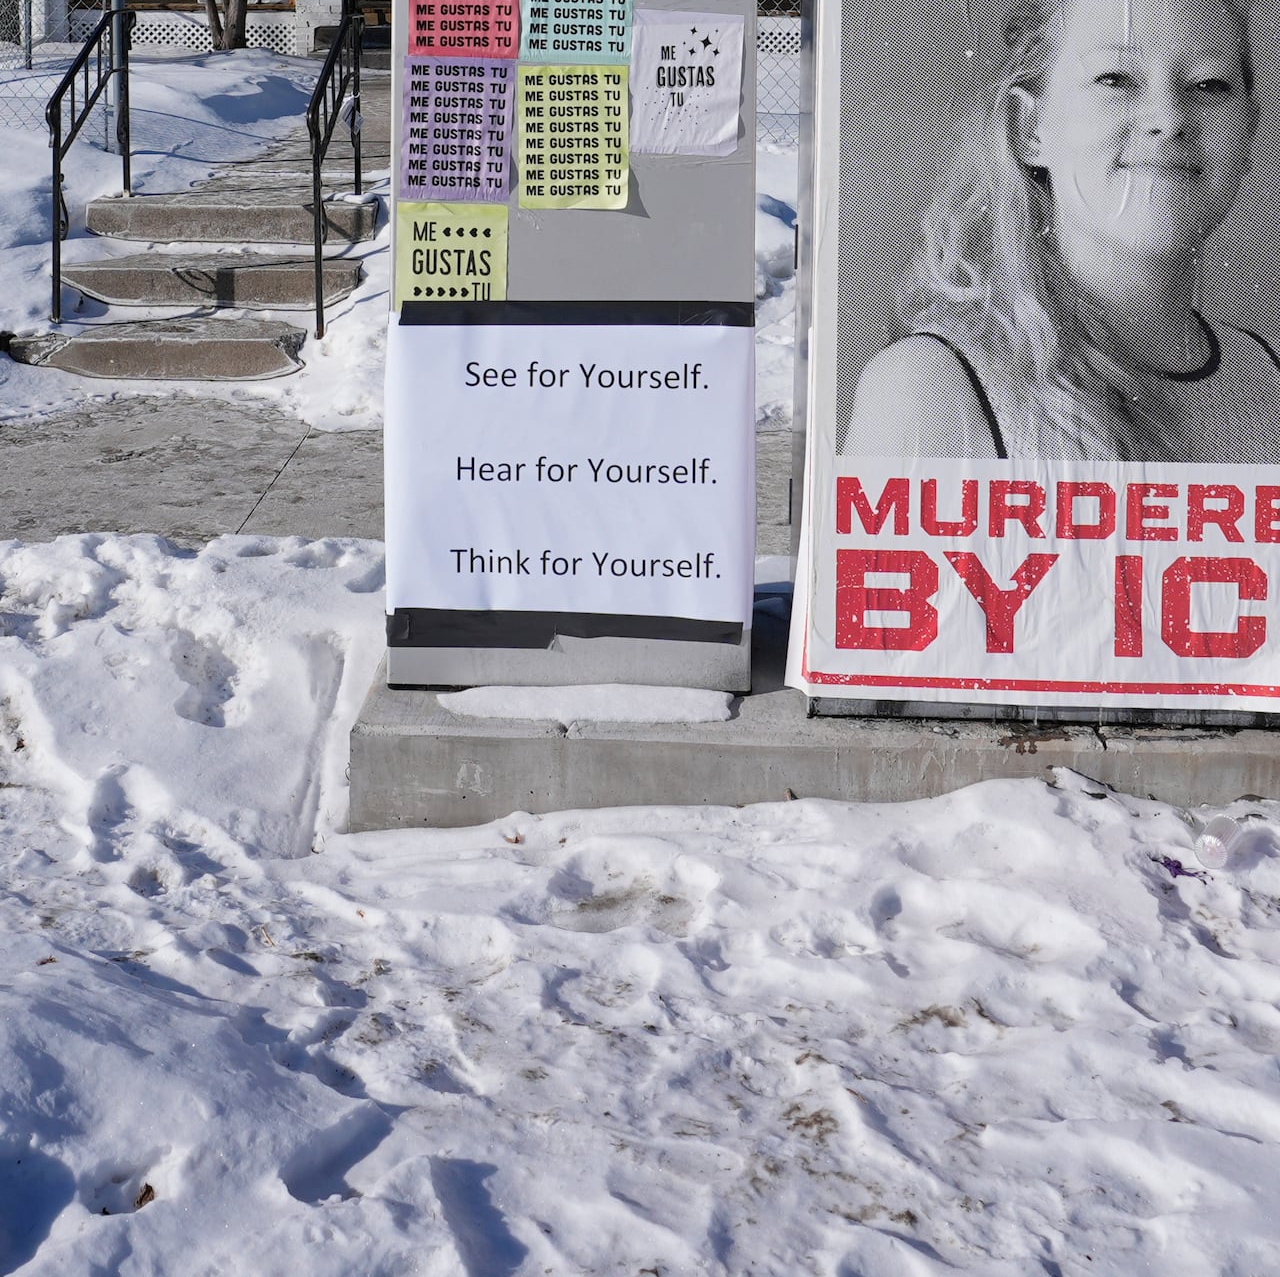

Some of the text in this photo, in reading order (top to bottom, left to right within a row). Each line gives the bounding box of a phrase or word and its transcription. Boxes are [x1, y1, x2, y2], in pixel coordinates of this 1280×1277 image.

[417, 5, 512, 15] ME GUSTAS TU
[531, 8, 625, 20] ME GUSTAS TU
[417, 20, 511, 31] ME GUSTAS TU
[530, 23, 624, 36] ME GUSTAS TU
[416, 36, 511, 47] ME GUSTAS TU
[529, 39, 624, 52] ME GUSTAS TU
[661, 46, 676, 60] ME
[412, 65, 507, 78] ME GUSTAS TU
[657, 66, 715, 87] GUSTAS
[526, 75, 620, 85] ME GUSTAS TU
[411, 81, 506, 94] ME GUSTAS TU
[526, 91, 620, 101] ME GUSTAS TU
[669, 92, 684, 107] TU
[411, 97, 505, 109] ME GUSTAS TU
[526, 106, 620, 117] ME GUSTAS TU
[411, 112, 504, 125] ME GUSTAS TU
[526, 122, 620, 132] ME GUSTAS TU
[410, 128, 503, 141] ME GUSTAS TU
[527, 138, 621, 148] ME GUSTAS TU
[410, 144, 503, 157] ME GUSTAS TU
[527, 154, 621, 164] ME GUSTAS TU
[409, 160, 502, 172] ME GUSTAS TU
[408, 175, 502, 188] ME GUSTAS TU
[527, 170, 621, 180] ME GUSTAS TU
[527, 185, 620, 195] ME GUSTAS TU
[414, 222, 437, 241] ME
[413, 249, 492, 276] GUSTAS
[472, 283, 491, 300] TU
[465, 361, 707, 389] See for Yourself.
[457, 456, 716, 483] Hear for Yourself.
[449, 547, 720, 578] Think for Yourself.
[836, 549, 1059, 653] BY
